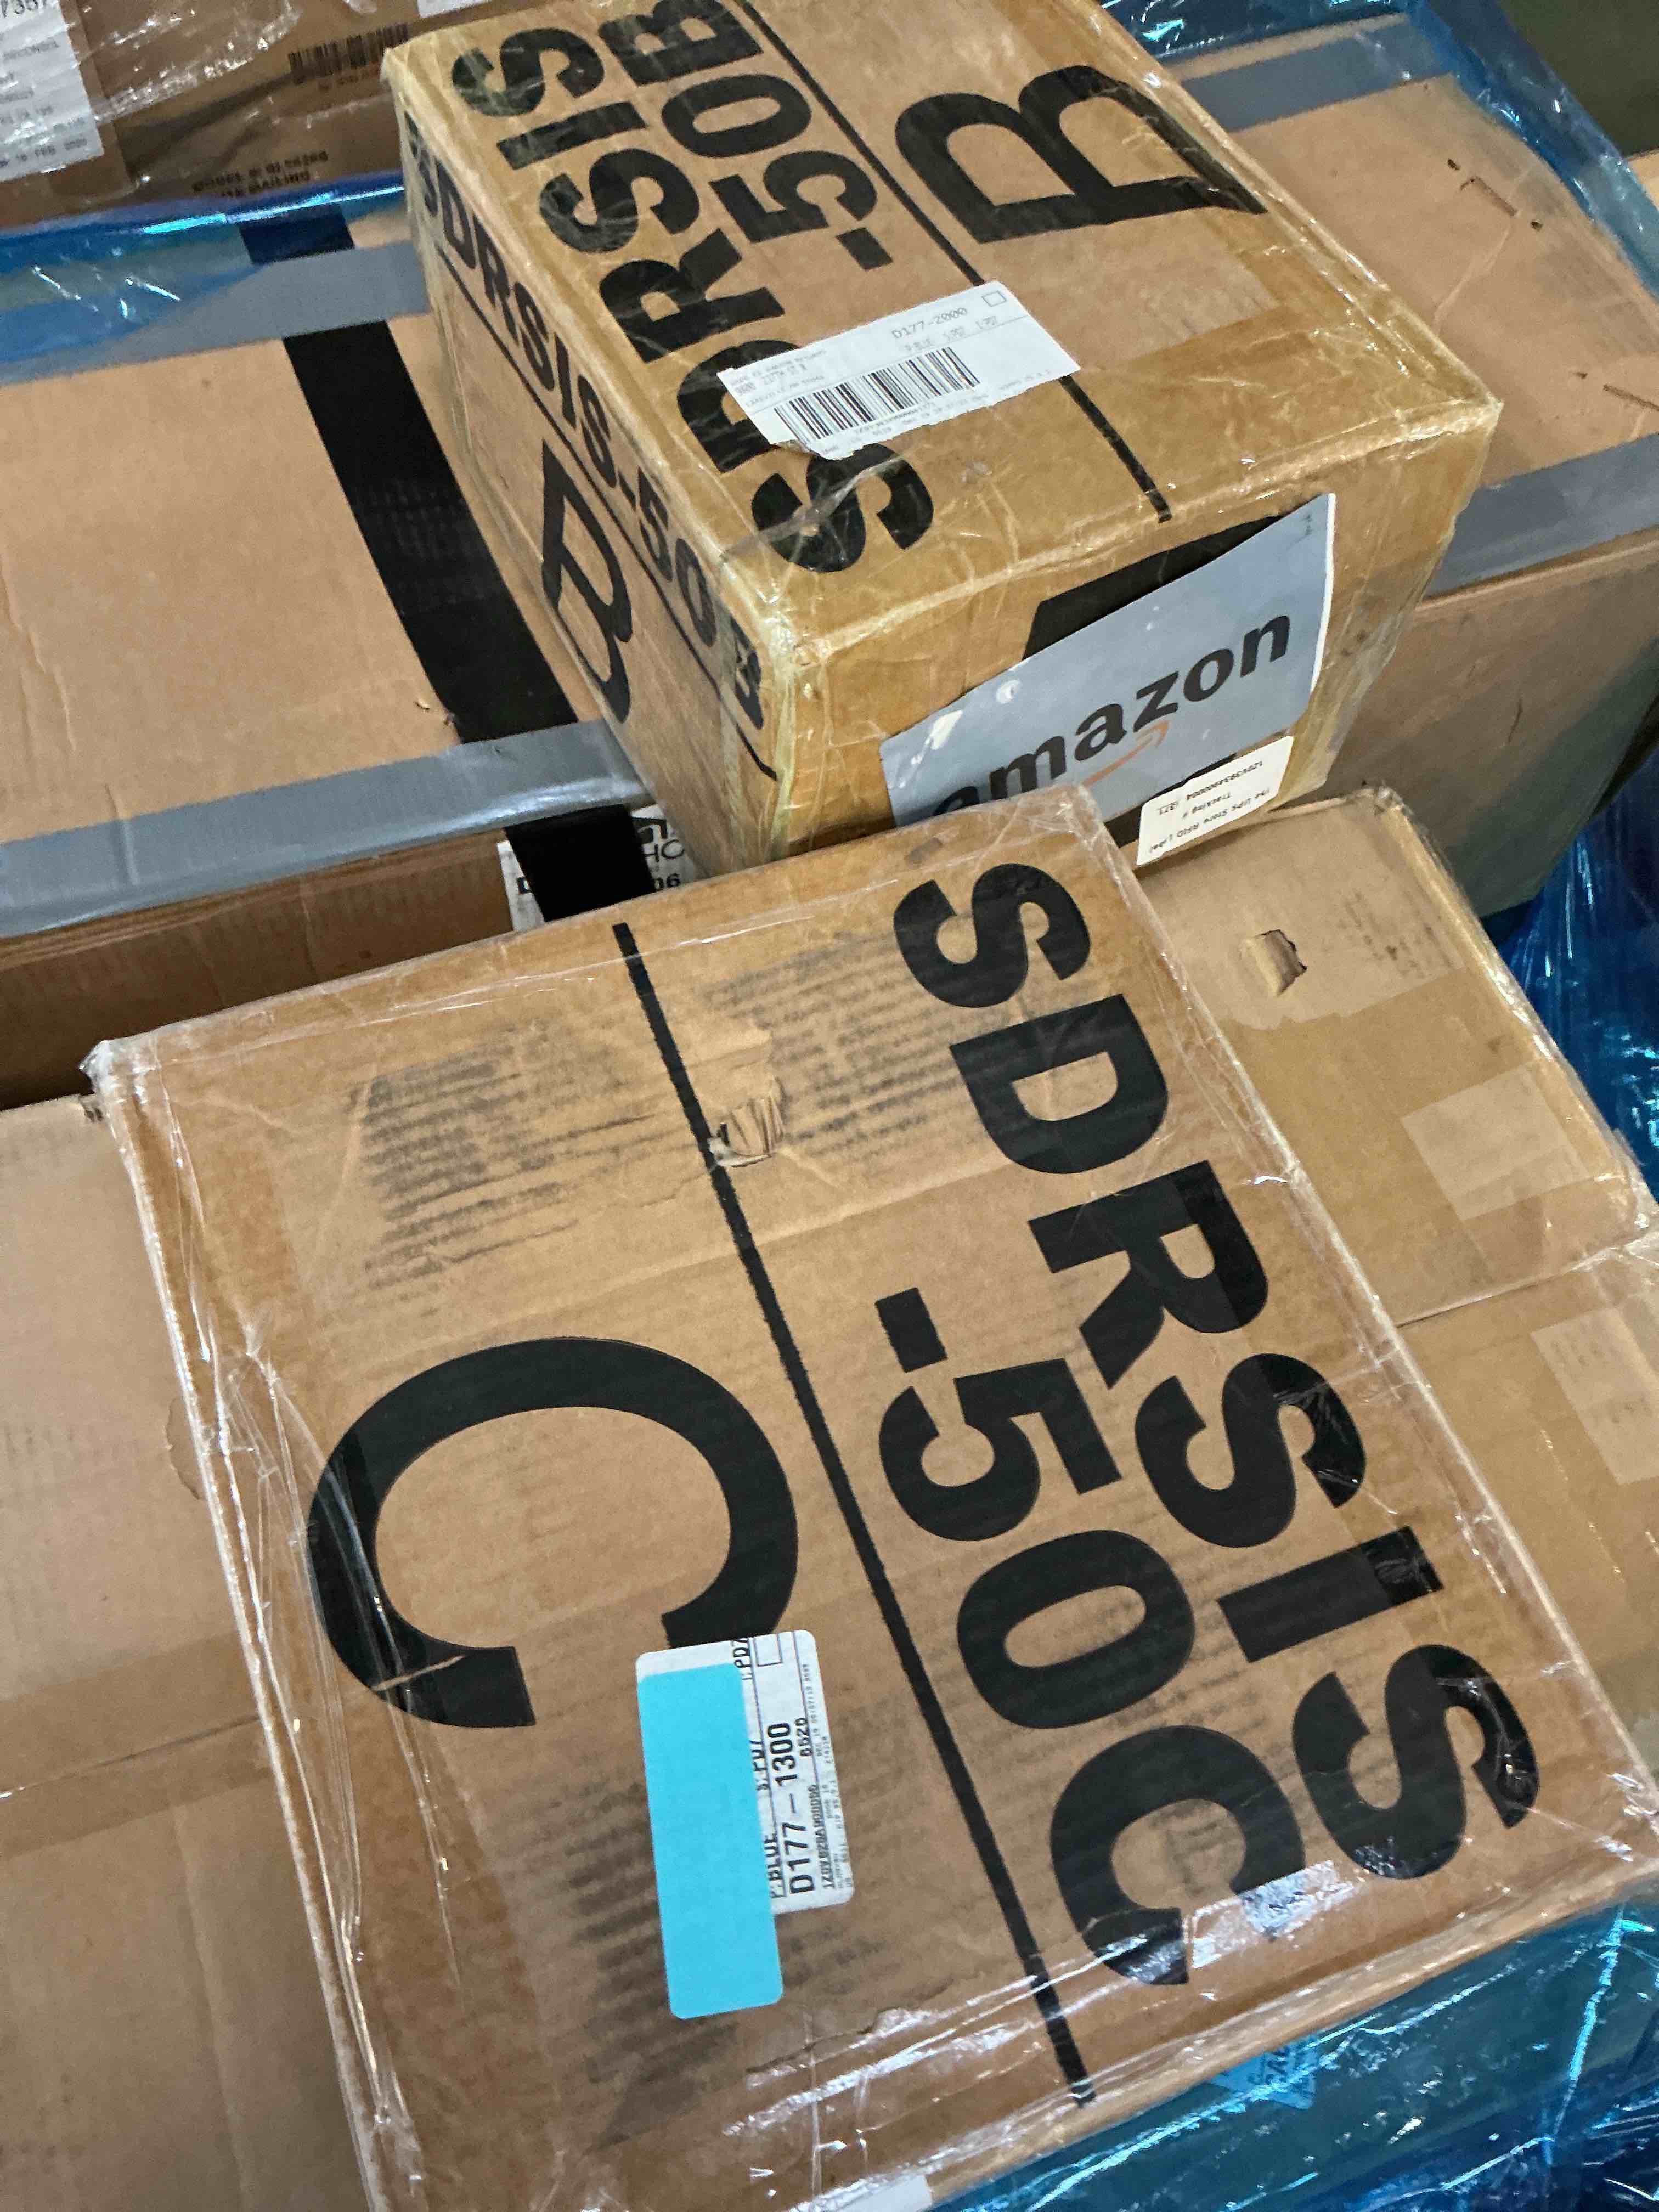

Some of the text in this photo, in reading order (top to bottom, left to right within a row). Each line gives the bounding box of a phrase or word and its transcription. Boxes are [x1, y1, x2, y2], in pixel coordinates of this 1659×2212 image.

[452, 28, 934, 573] SDRSIS
[598, 0, 892, 271] -50B
[895, 65, 1269, 244] B
[1192, 792, 1232, 814] Tracking
[305, 1336, 799, 1728] C
[893, 862, 1540, 1880] SDRSIS
[874, 1286, 1306, 1985] -50C
